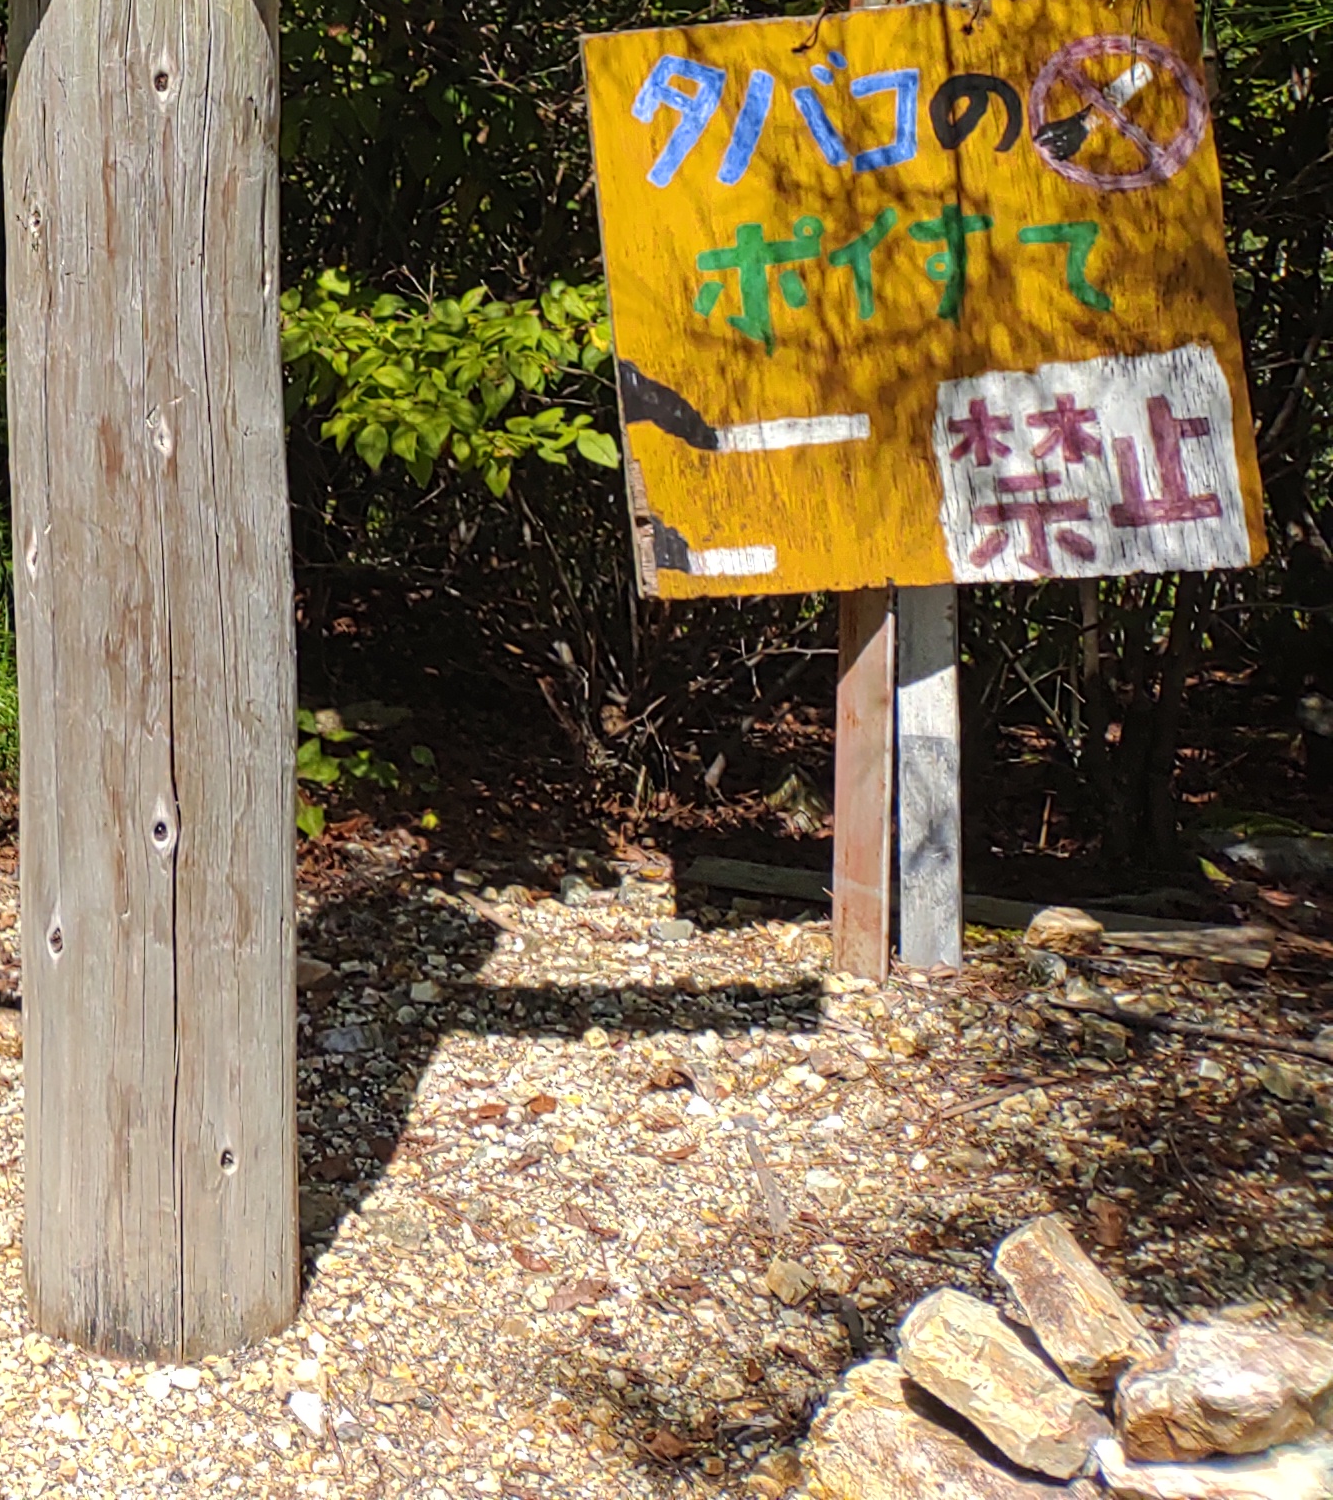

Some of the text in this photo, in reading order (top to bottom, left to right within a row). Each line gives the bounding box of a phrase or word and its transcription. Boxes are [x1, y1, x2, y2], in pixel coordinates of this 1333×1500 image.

[631, 50, 1023, 188] タバコの
[693, 204, 1113, 357] ポイすて
[947, 393, 1223, 578] 禁止
